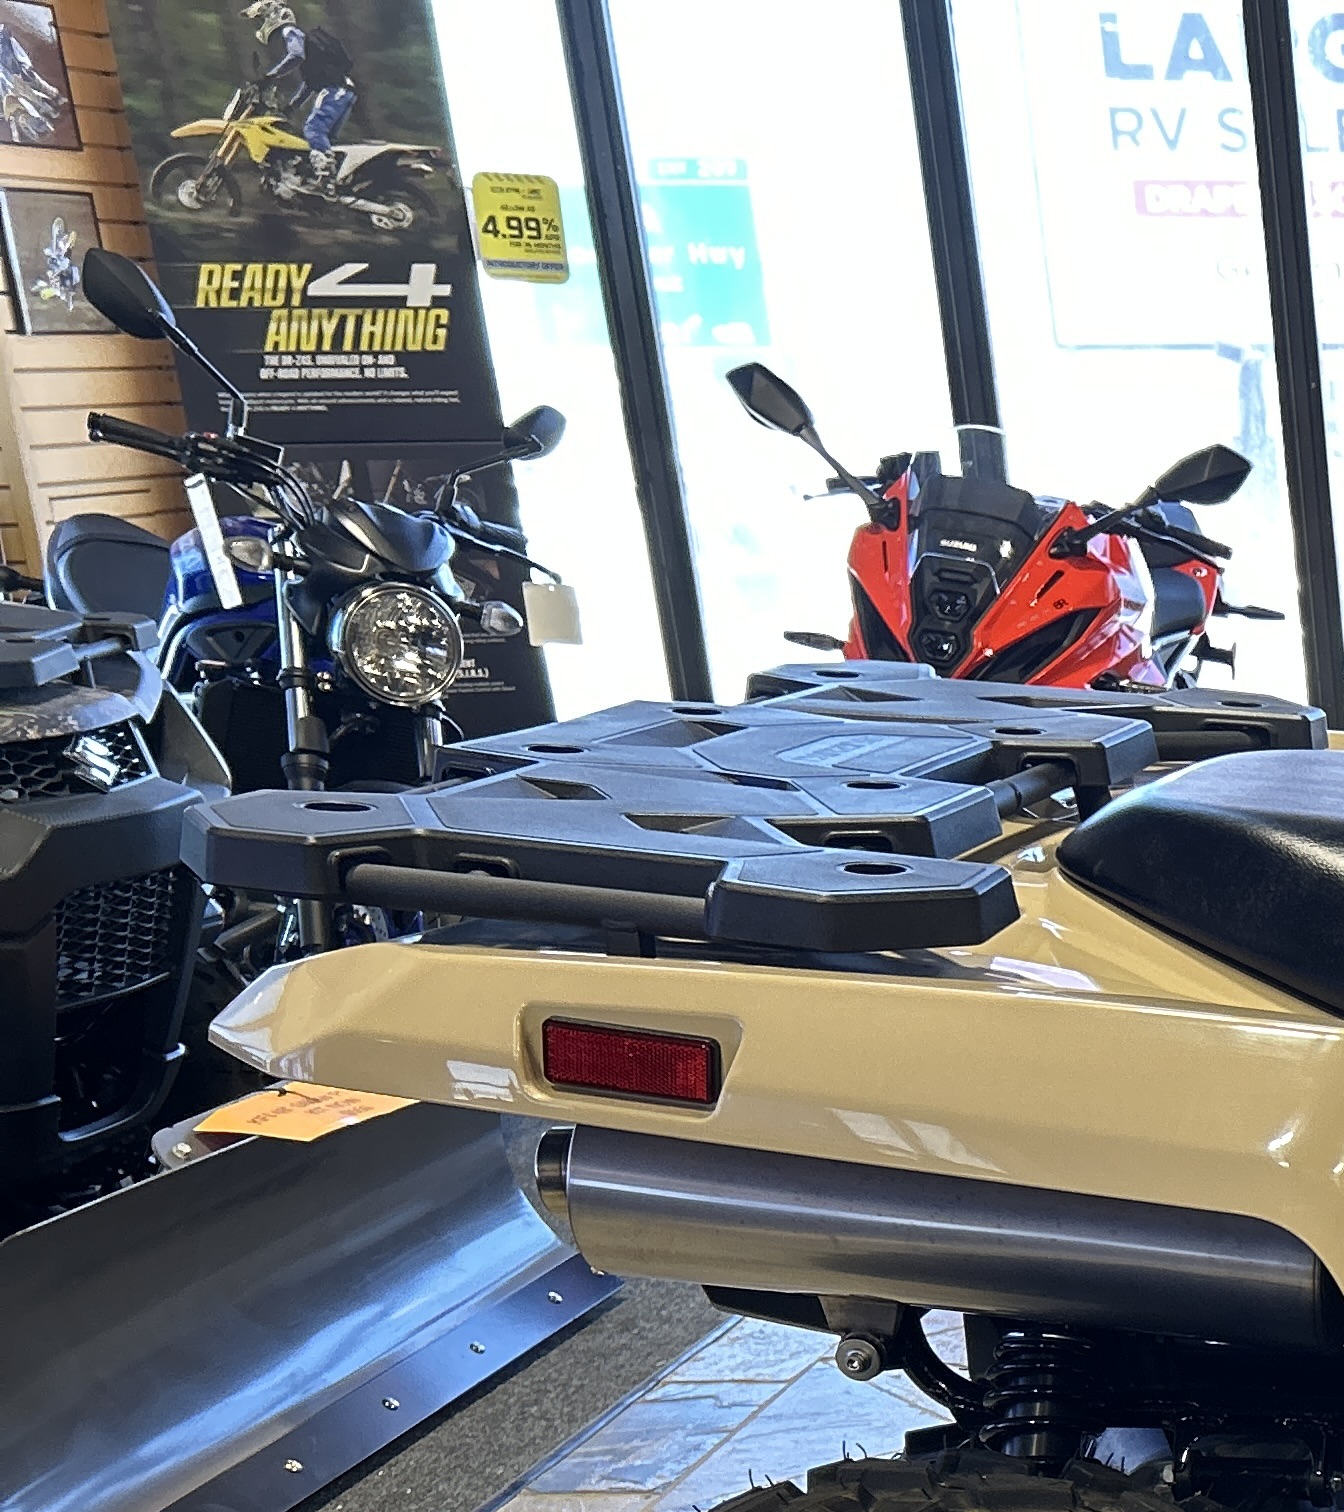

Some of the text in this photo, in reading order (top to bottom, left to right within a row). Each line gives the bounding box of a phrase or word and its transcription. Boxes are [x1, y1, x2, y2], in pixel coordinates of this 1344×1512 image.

[1109, 106, 1186, 152] RV
[1143, 183, 1250, 215] DRAPE
[196, 263, 452, 308] READY 4
[264, 308, 449, 352] ANYTHING
